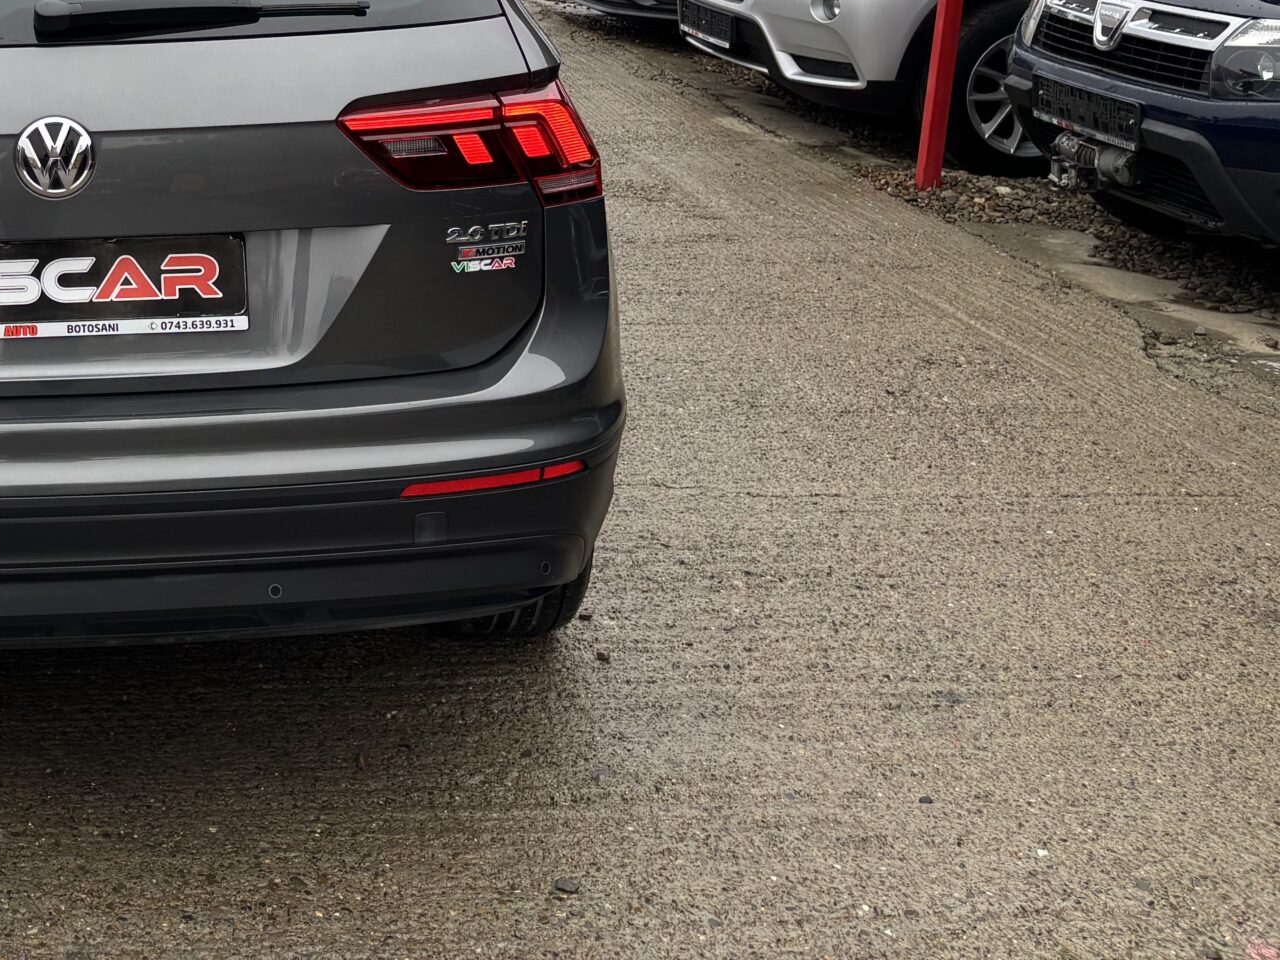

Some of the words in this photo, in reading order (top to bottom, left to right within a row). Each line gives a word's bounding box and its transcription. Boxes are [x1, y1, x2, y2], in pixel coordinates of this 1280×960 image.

[451, 257, 516, 273] VISCAR
[3, 325, 38, 337] AUTO
[67, 322, 119, 334] BOTOSANI
[160, 319, 236, 331] 0743.639.931
